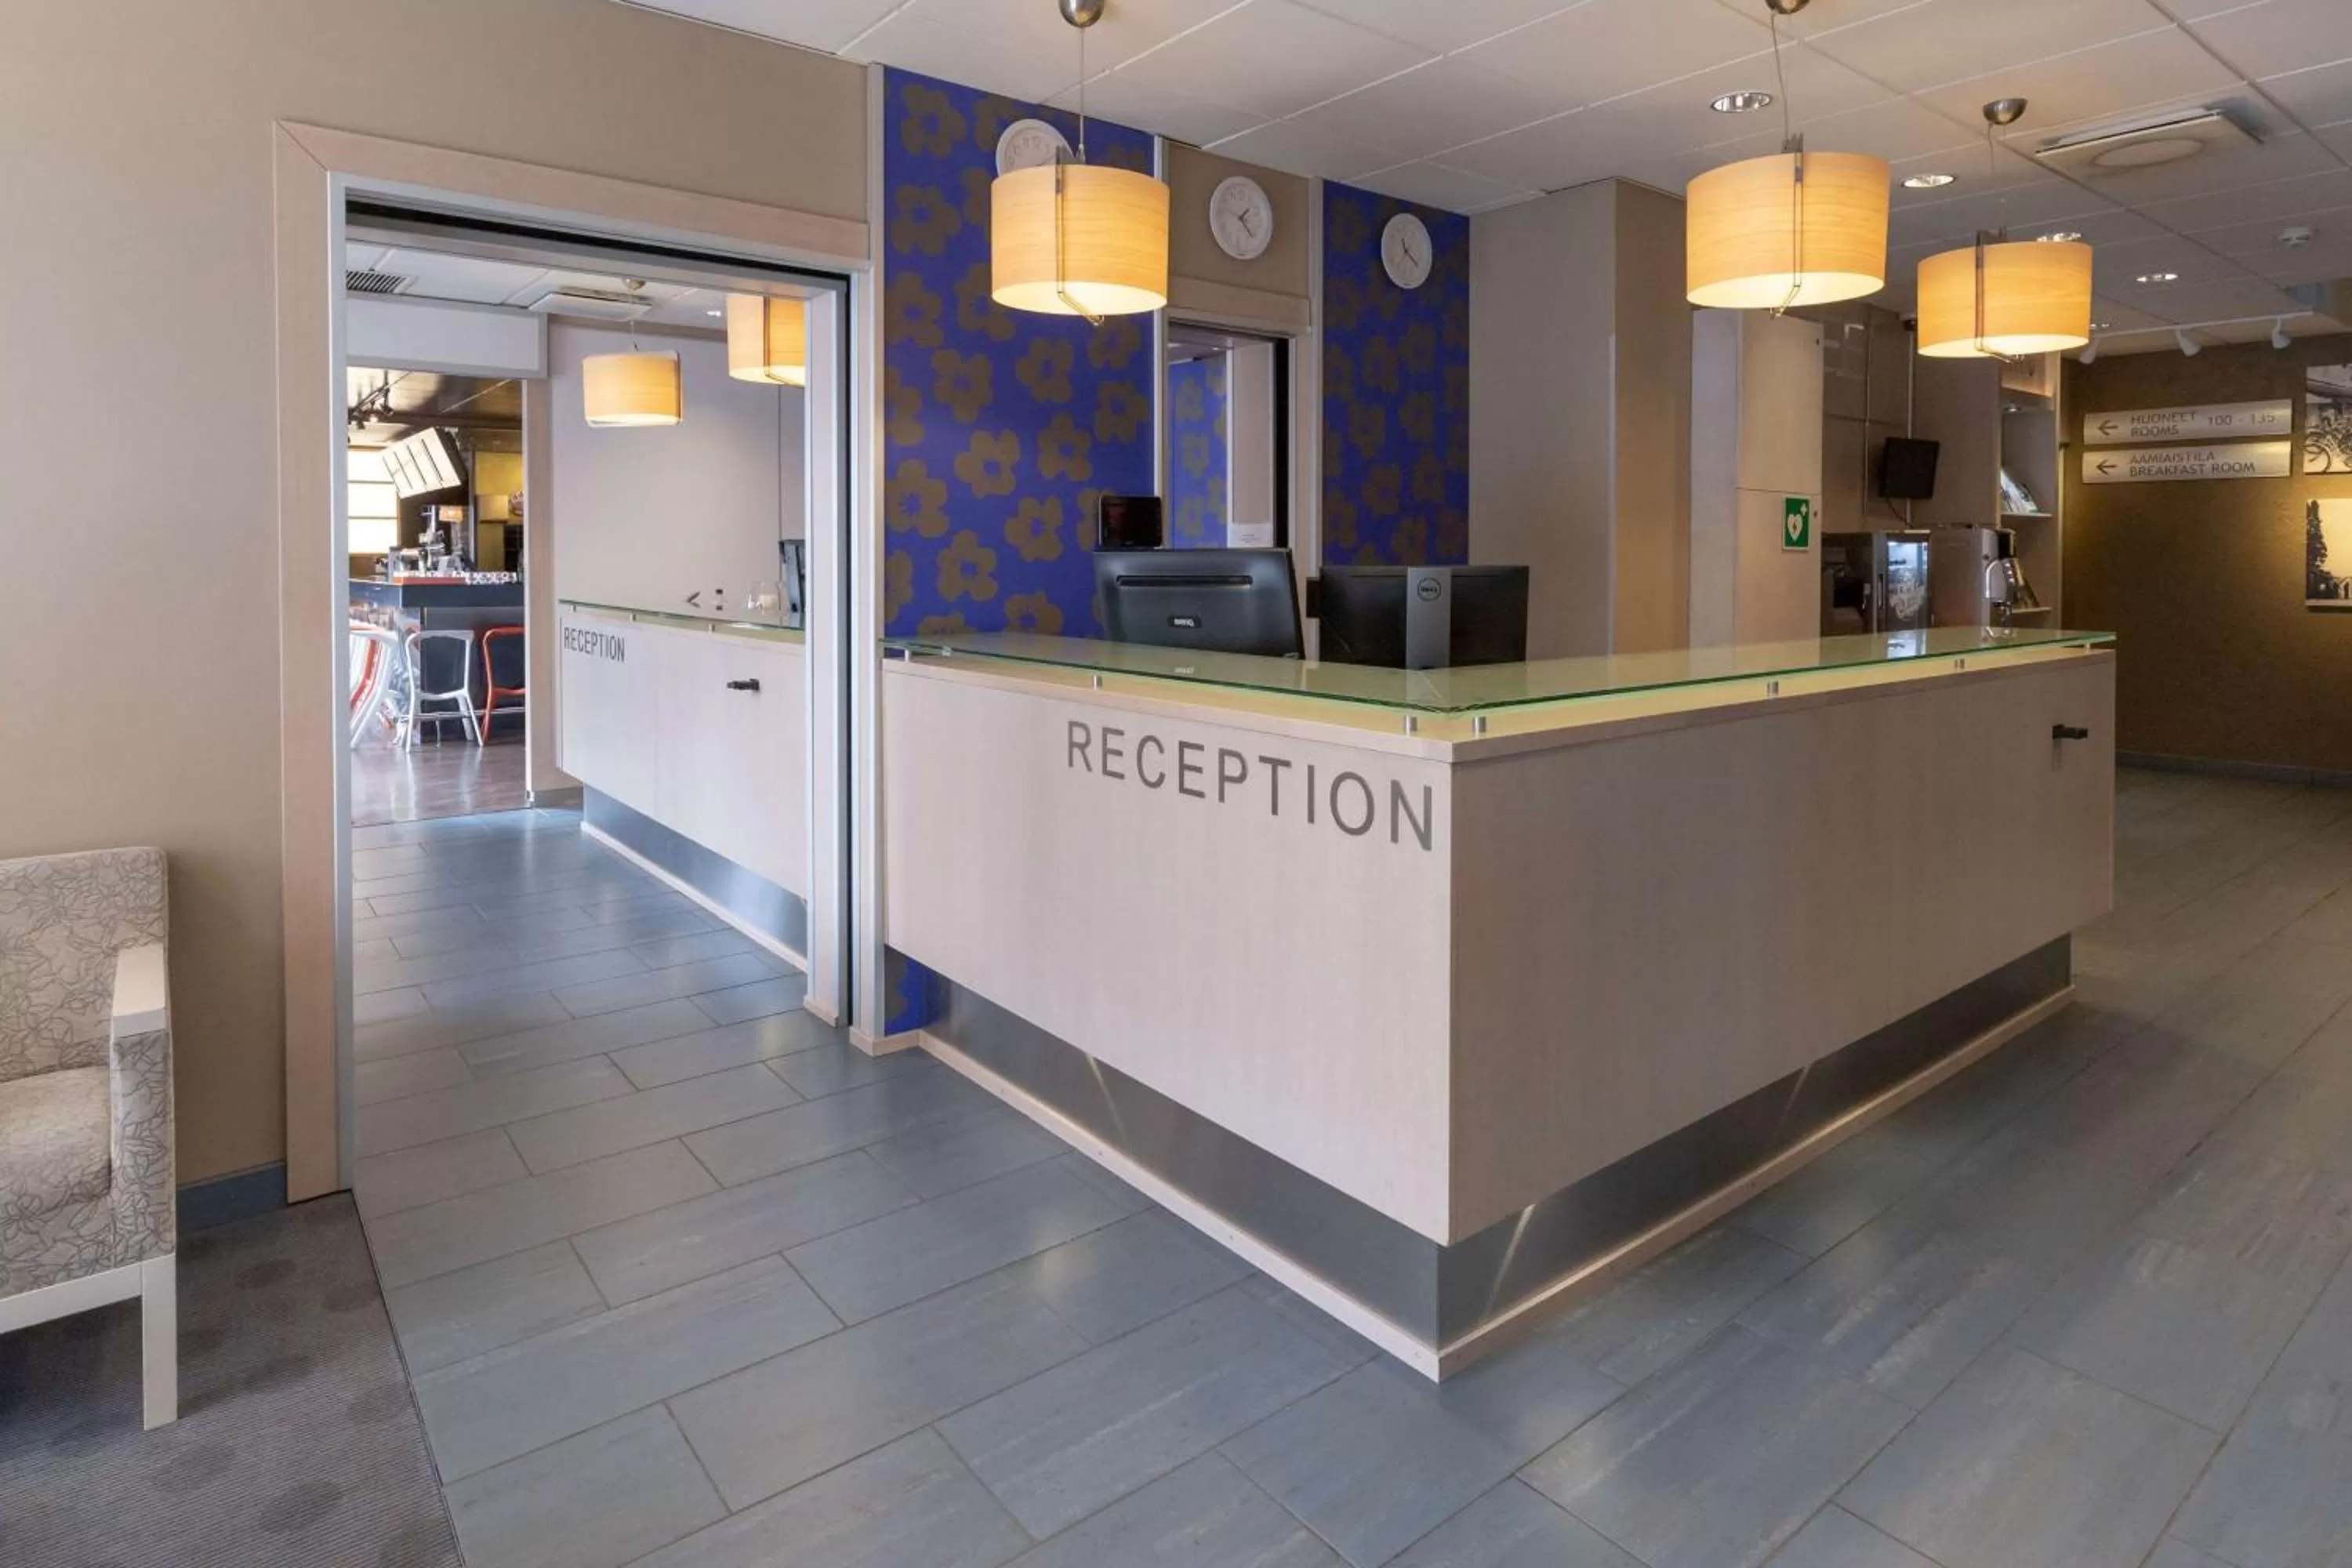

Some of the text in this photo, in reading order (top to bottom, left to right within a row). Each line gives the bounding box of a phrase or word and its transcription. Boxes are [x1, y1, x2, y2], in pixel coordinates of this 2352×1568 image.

[2131, 411, 2197, 424] HUONEET
[2208, 415, 2232, 426] 100
[2130, 424, 2180, 437] ROOMS
[2129, 451, 2216, 465] AAMIAISTILA
[2129, 462, 2256, 477] BREAKFAST ROOM
[563, 626, 625, 662] RECEPTION
[1067, 720, 1433, 851] RECEPTION
